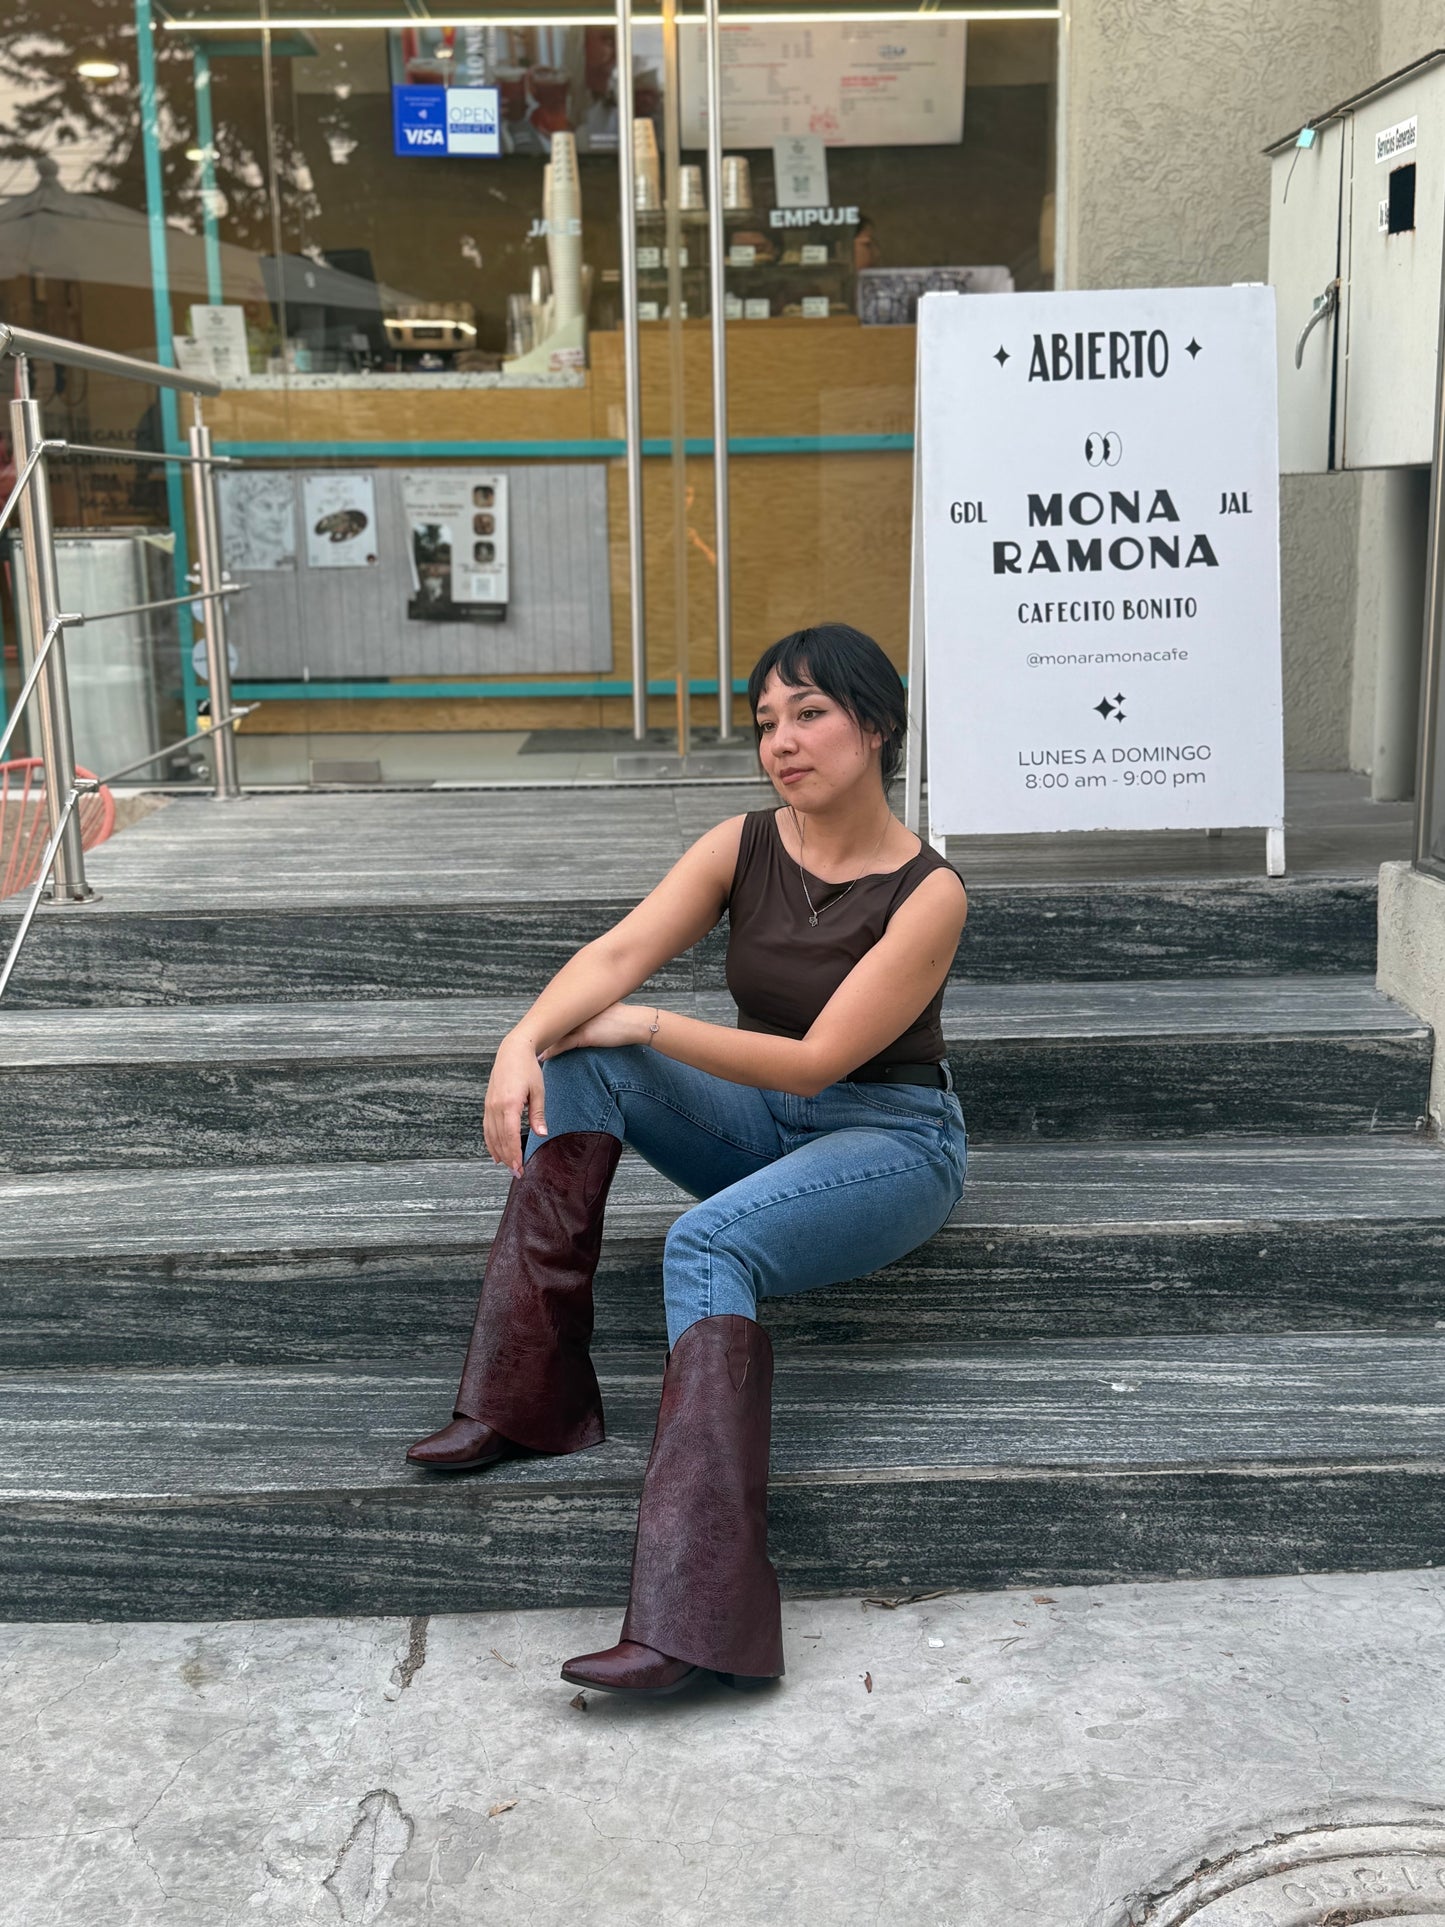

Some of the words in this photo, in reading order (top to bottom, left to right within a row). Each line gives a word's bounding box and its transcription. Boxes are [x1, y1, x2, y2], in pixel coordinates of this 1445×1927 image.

[449, 106, 495, 122] OPEN
[404, 129, 444, 145] VISA
[1377, 132, 1395, 158] Servicios
[1396, 122, 1415, 150] Generales
[769, 206, 860, 228] EMPUJE
[1028, 329, 1169, 382] ABIERTO
[950, 501, 988, 524] GDL
[1027, 489, 1180, 527] MONA
[1219, 491, 1252, 515] JAL
[993, 534, 1219, 574] RAMONA
[1018, 600, 1115, 623] CAFECITO
[1122, 597, 1198, 620] BONITO
[1026, 648, 1189, 668] @monaramonacafe
[1019, 750, 1086, 766] LUNES
[1092, 749, 1106, 763] A
[1112, 745, 1211, 763] DOMINGO
[1025, 773, 1069, 789] 8:00
[1075, 775, 1107, 787] am
[1123, 770, 1167, 786] 9:00
[1172, 771, 1206, 788] pm
